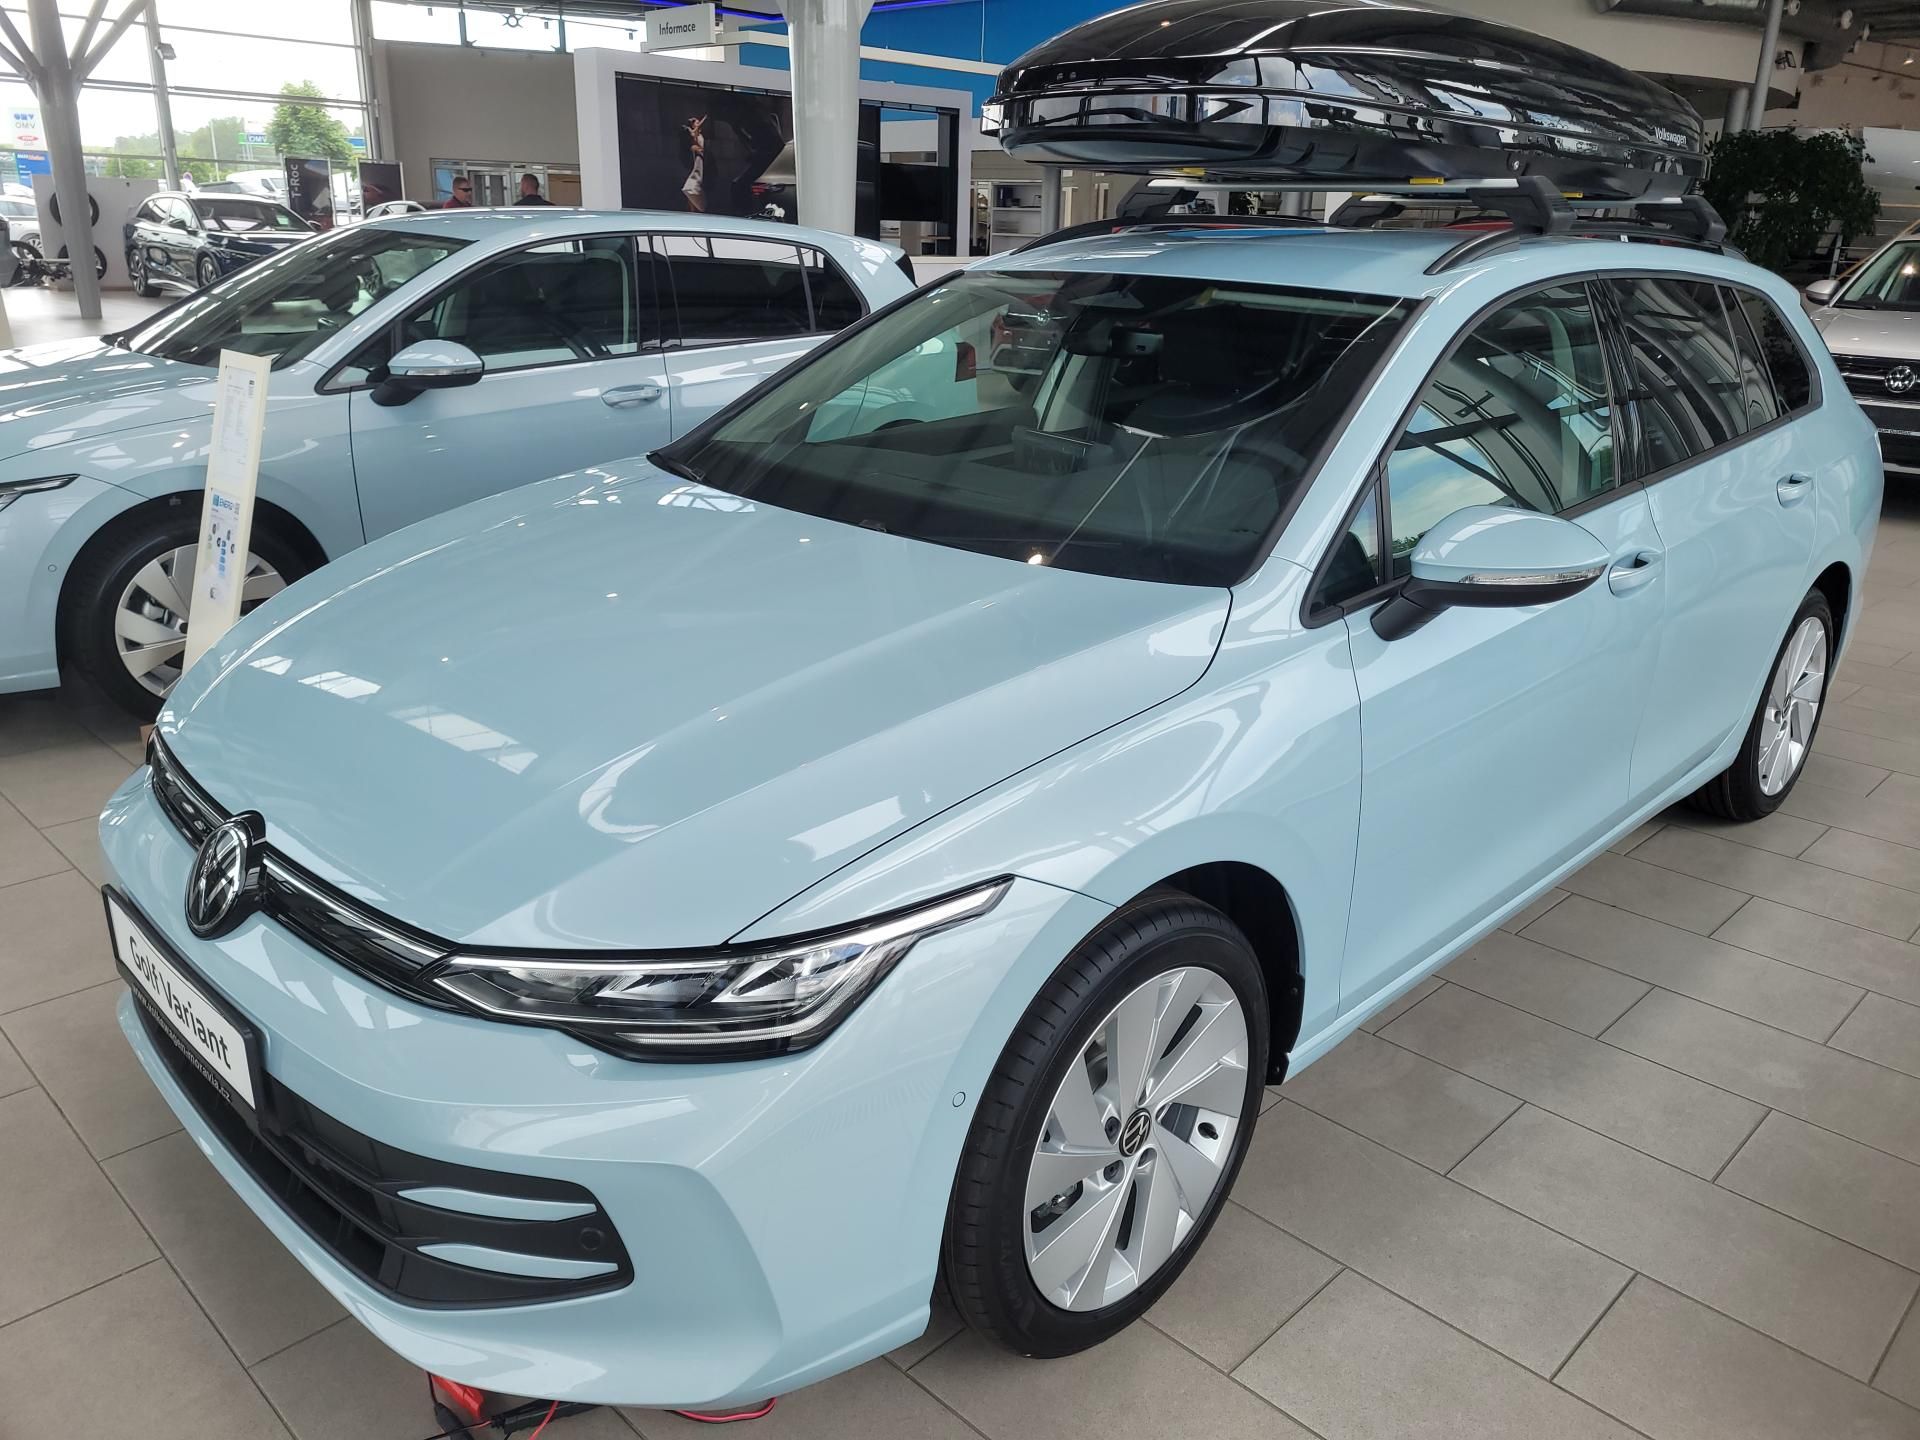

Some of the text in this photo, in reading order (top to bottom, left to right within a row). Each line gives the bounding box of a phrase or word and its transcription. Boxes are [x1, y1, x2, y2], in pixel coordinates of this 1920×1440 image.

[658, 21, 696, 36] Informace
[248, 134, 267, 143] OMV
[1654, 126, 1687, 146] Volkswagen
[129, 935, 232, 1070] Golf Variant
